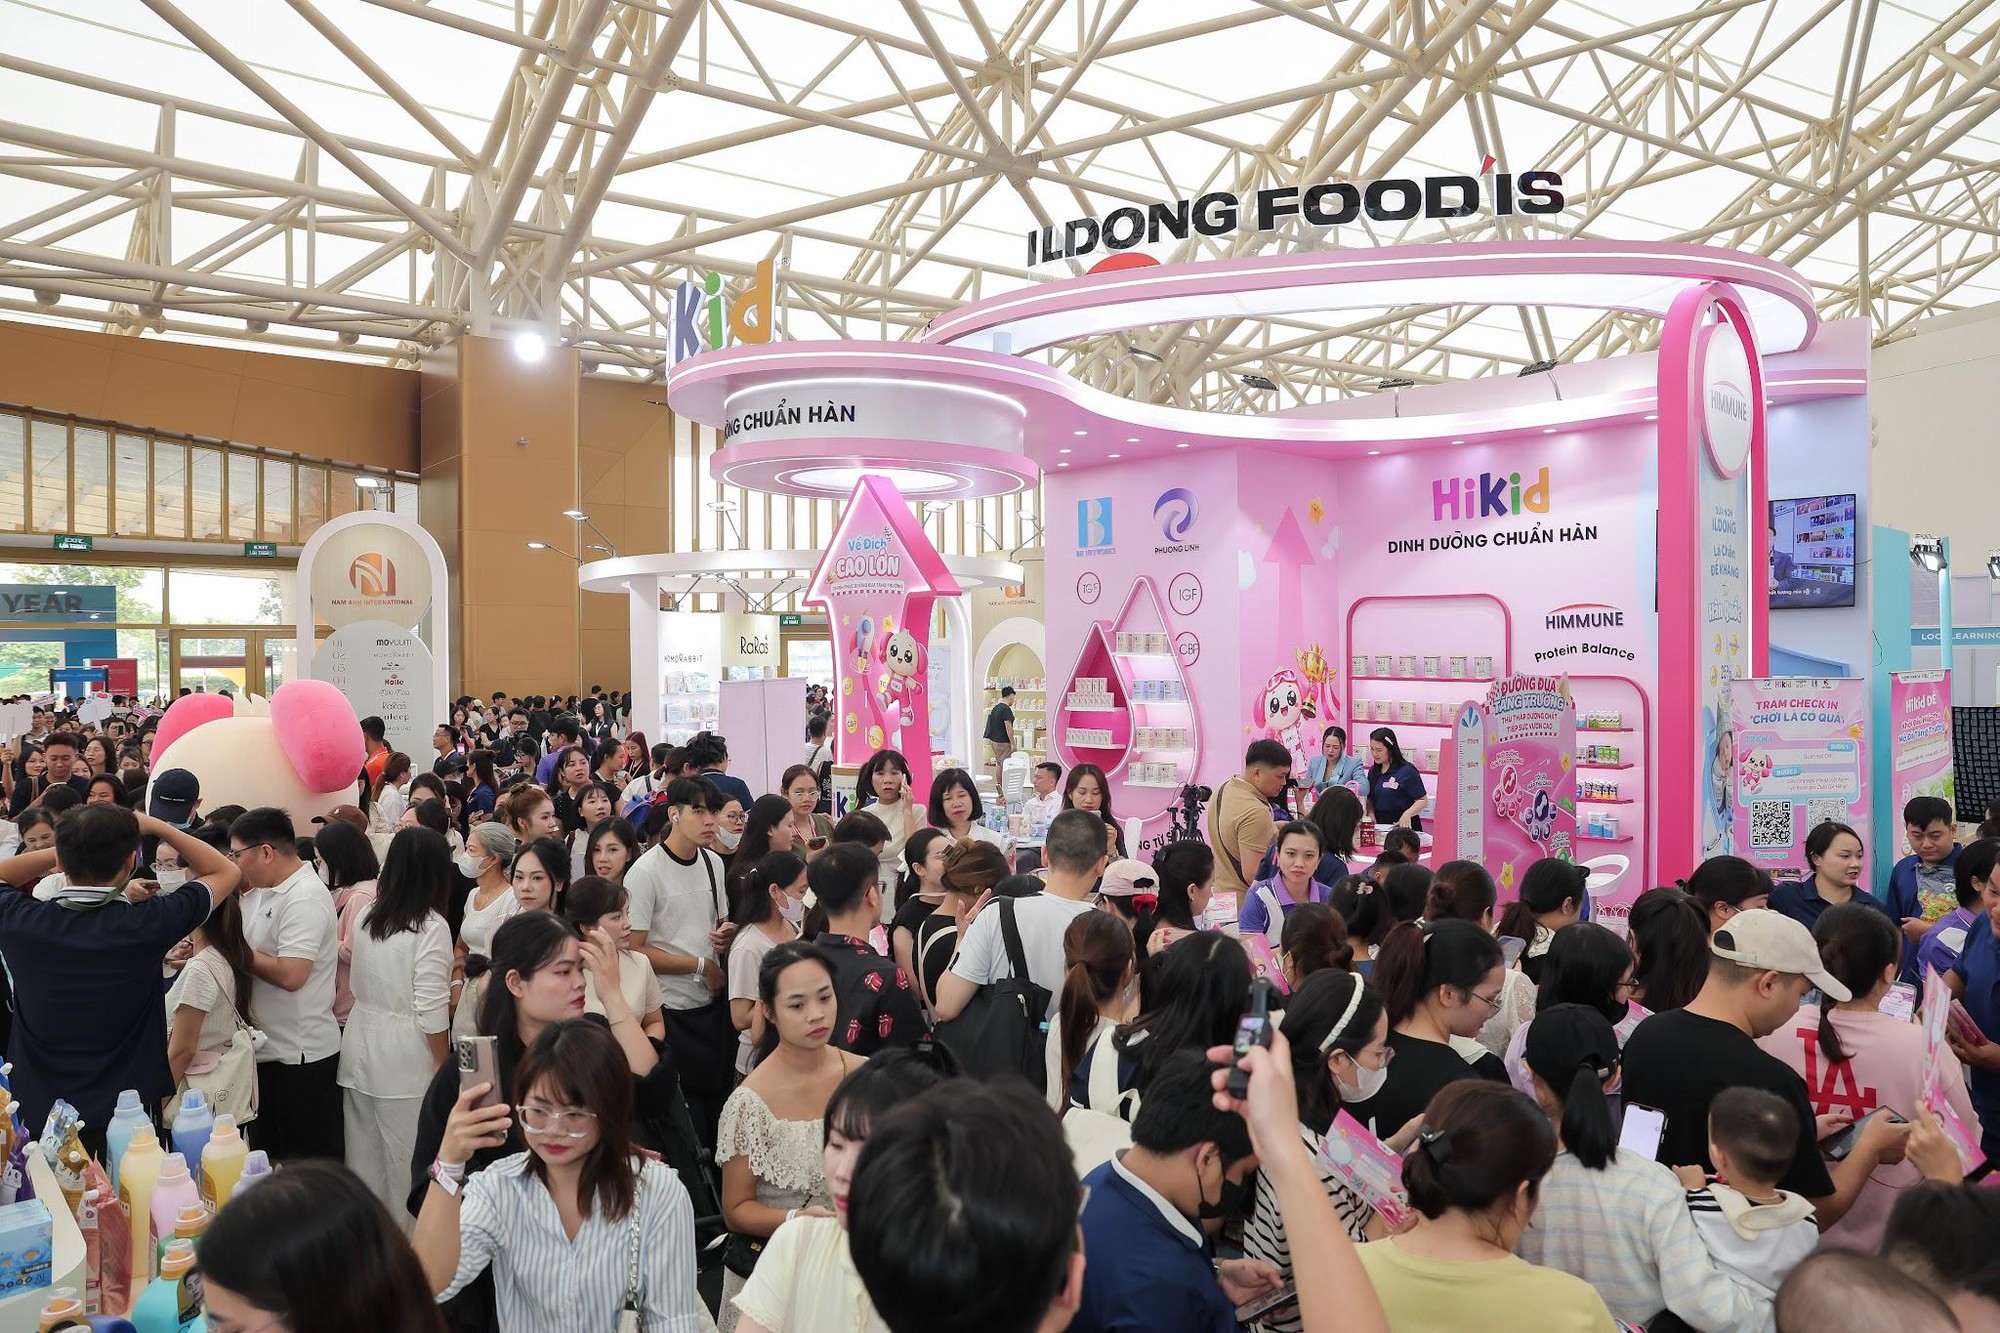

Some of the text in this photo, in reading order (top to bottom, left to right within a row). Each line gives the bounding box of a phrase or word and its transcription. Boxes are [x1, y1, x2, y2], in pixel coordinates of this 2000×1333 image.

[1027, 191, 1238, 267] ILDONG
[744, 398, 801, 431] CHUẨN
[809, 400, 855, 423] HÀN
[1711, 389, 1747, 421] HIMMUNE
[1432, 466, 1550, 521] HiKid
[1388, 522, 1598, 554] DINH DƯỠNG CHUẨN HÀN
[1712, 517, 1737, 534] ILDONG
[836, 548, 900, 579] CAO LỚN
[1, 593, 83, 613] YEAR
[1179, 588, 1197, 601] IGF
[1545, 612, 1624, 630] HIMMUNE
[1534, 642, 1636, 663] Protein Balance
[1501, 674, 1536, 696] ĐƯỜNG
[1790, 698, 1825, 709] CHECK
[1827, 701, 1839, 710] IN
[1797, 1027, 1877, 1122] LA
